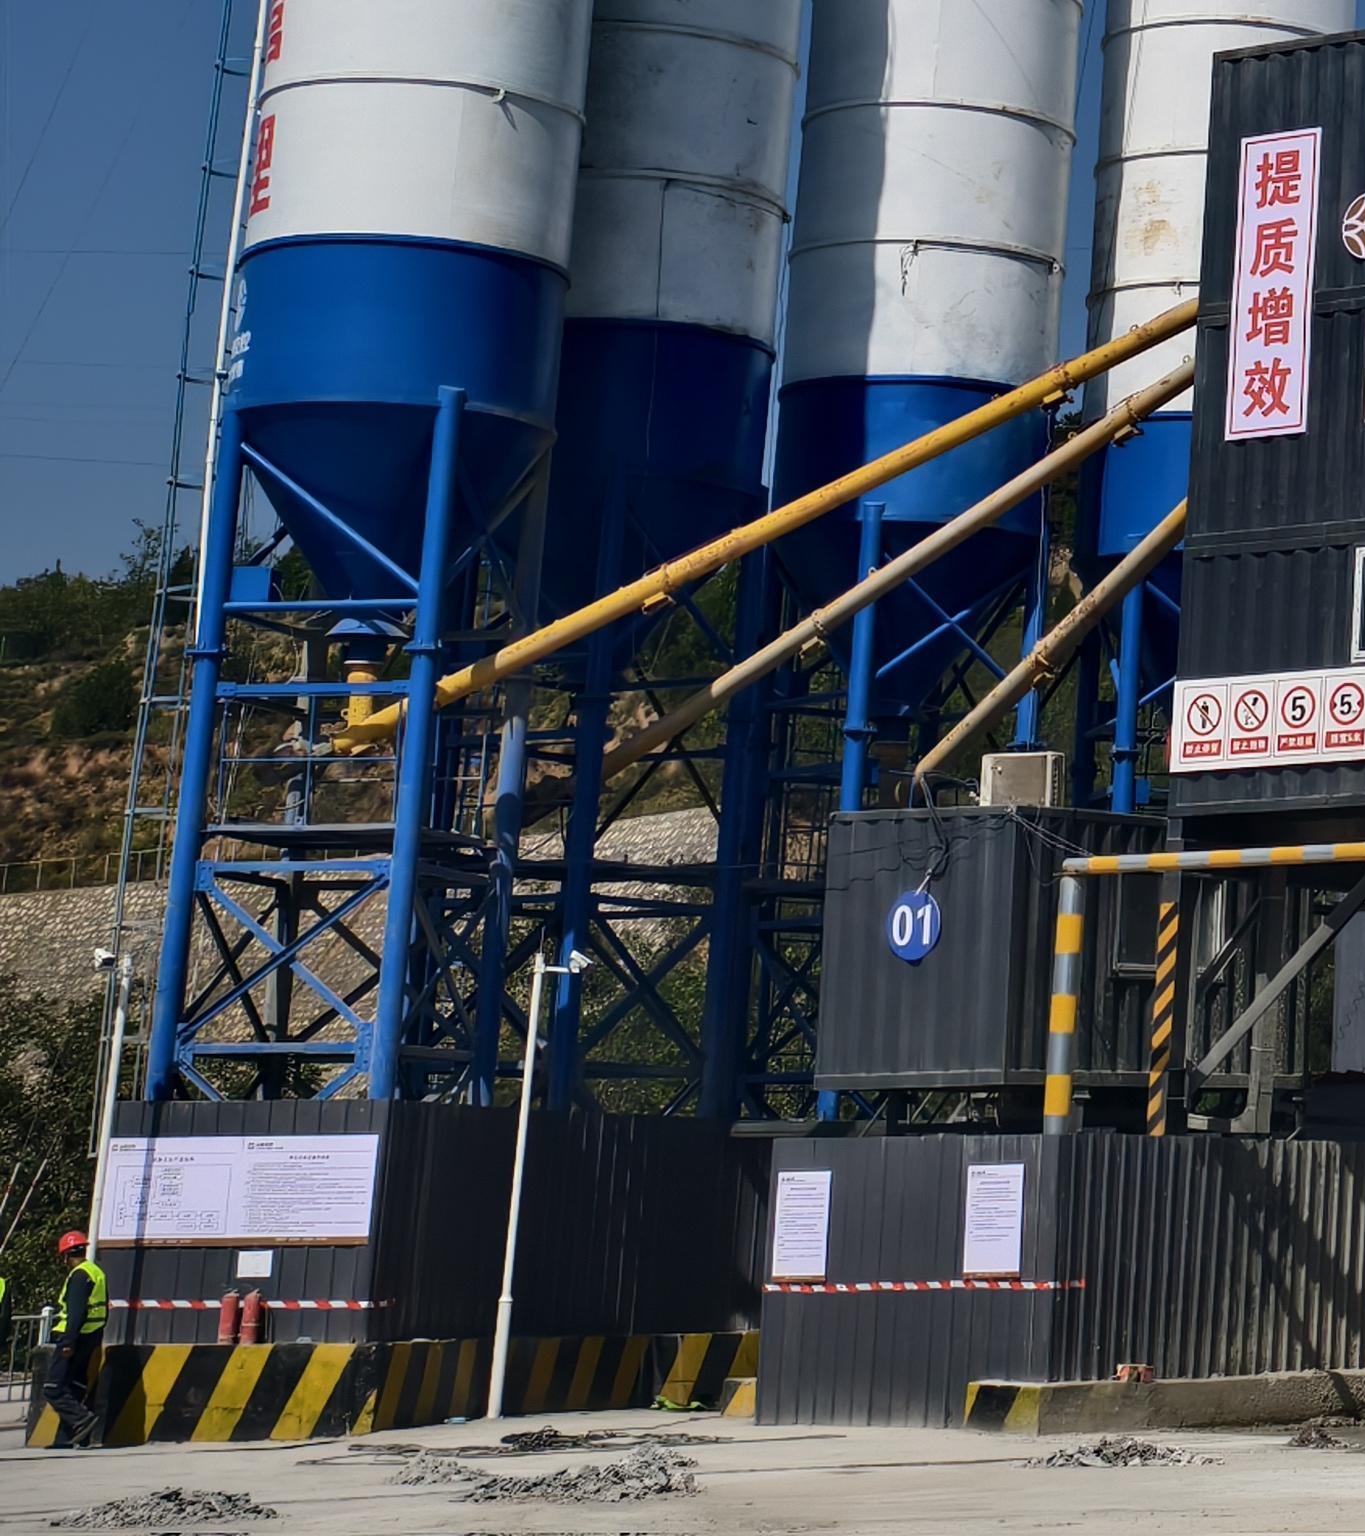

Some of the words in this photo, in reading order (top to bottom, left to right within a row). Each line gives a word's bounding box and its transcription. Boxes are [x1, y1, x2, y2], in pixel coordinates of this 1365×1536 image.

[1242, 149, 1302, 418] 提质增效
[1291, 695, 1306, 721] 5
[892, 904, 932, 946] 01
